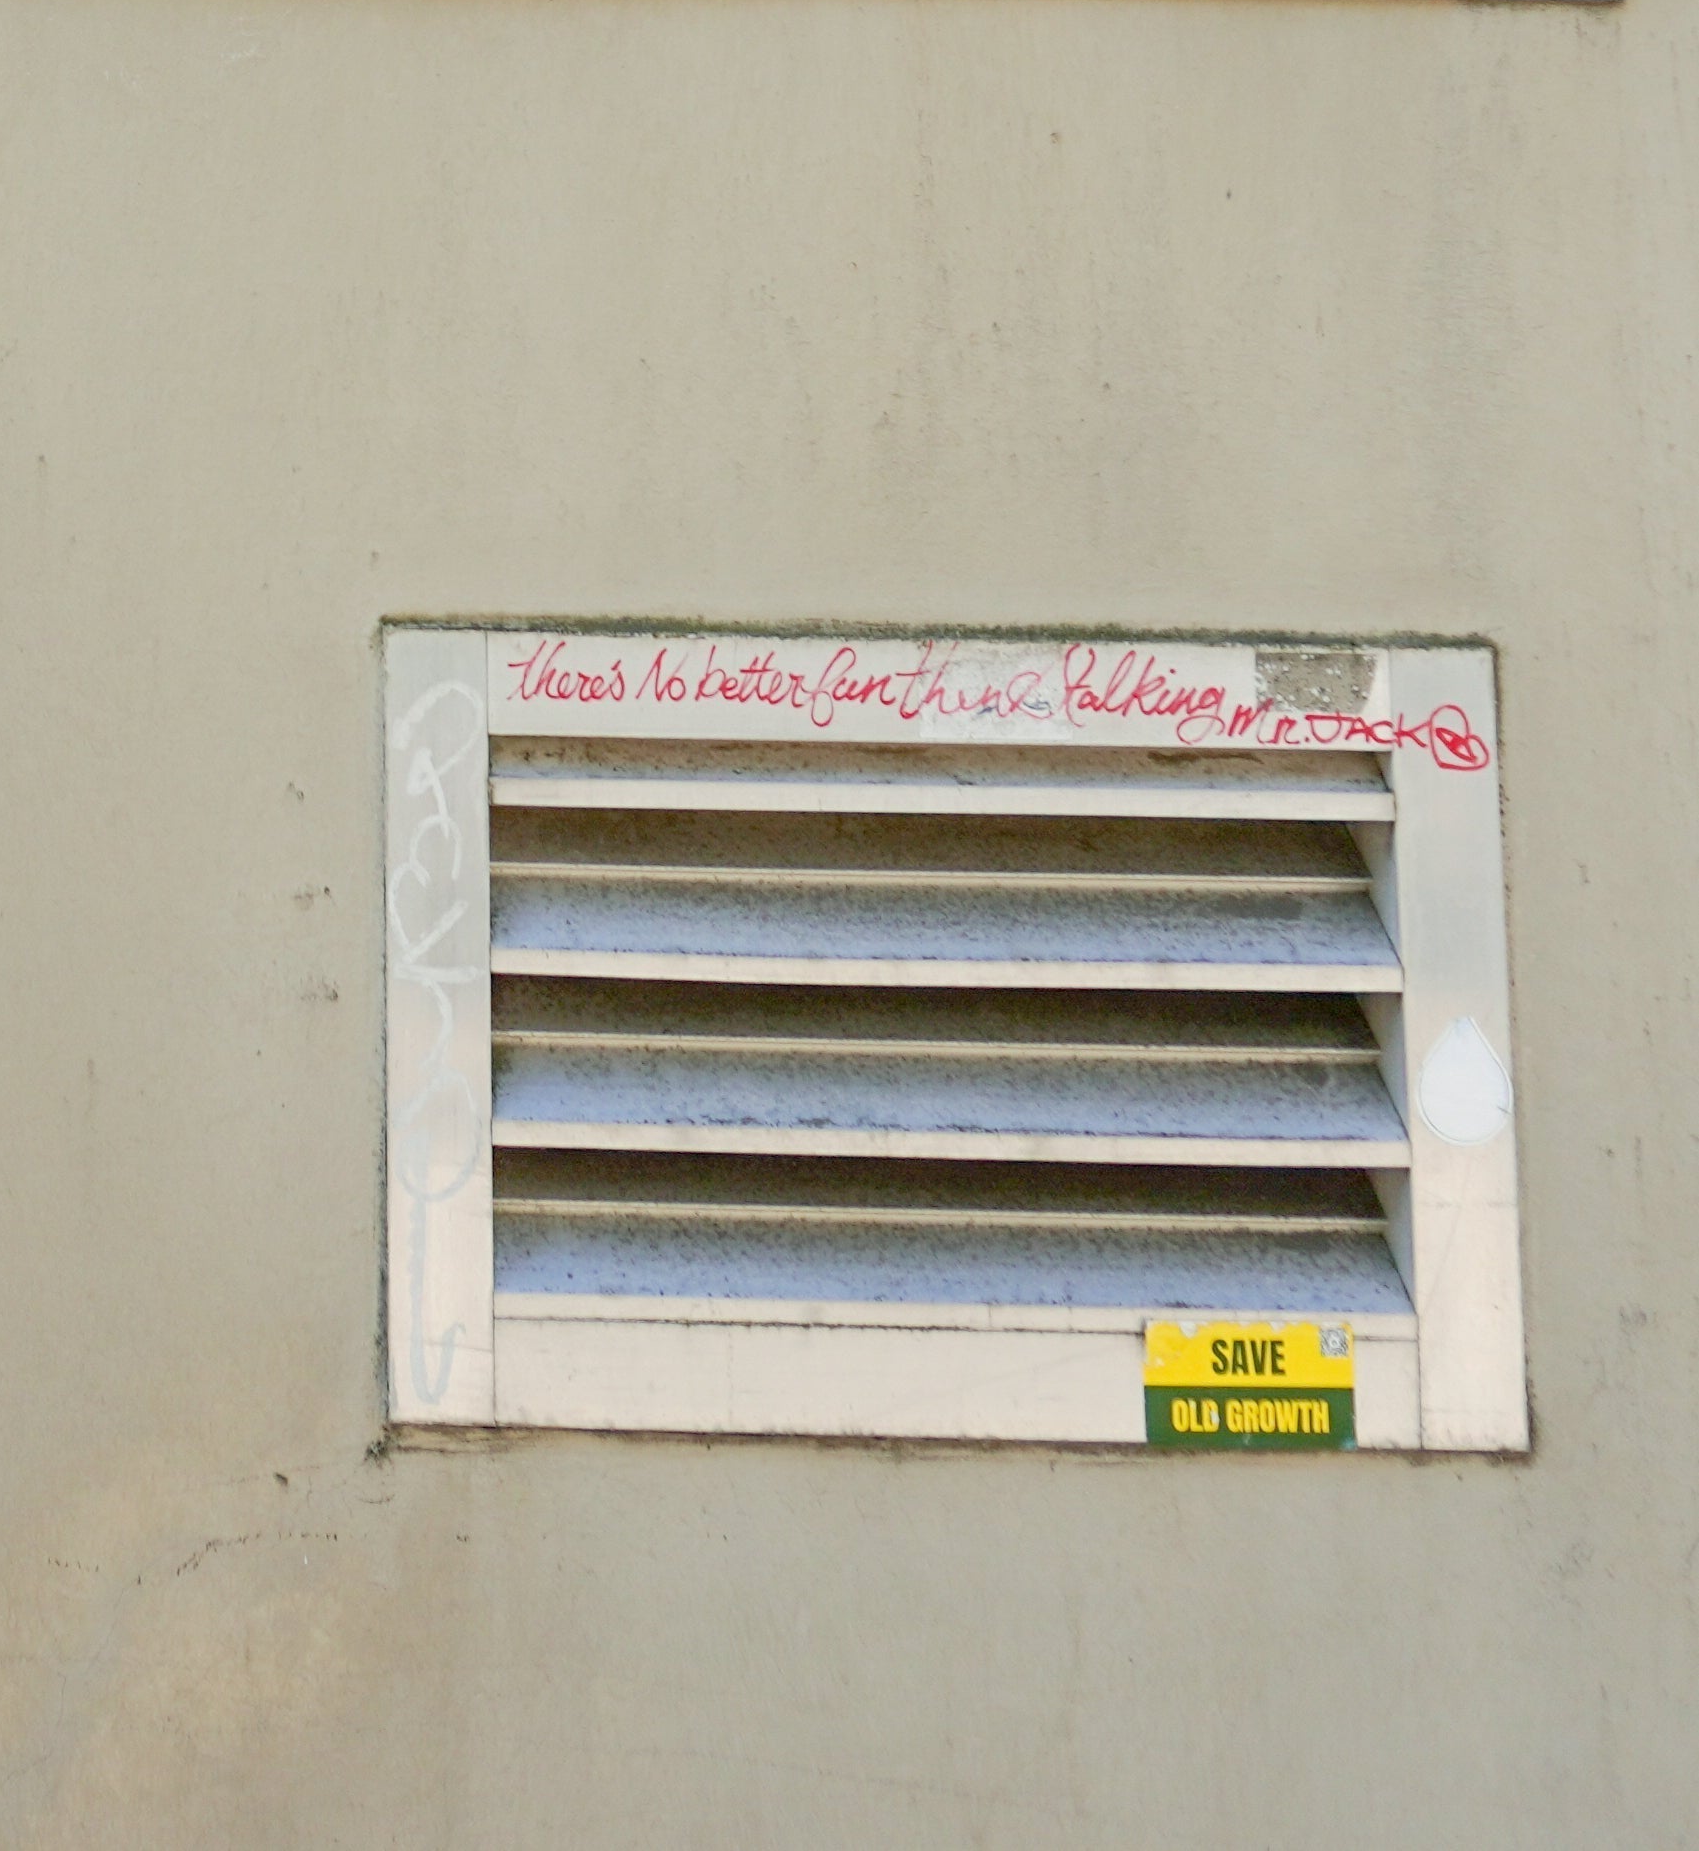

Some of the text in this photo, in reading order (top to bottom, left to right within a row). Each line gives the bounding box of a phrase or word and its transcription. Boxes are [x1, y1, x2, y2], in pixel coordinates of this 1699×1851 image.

[1211, 1339, 1286, 1376] SAVE
[1170, 1399, 1330, 1434] OLD GROWTH
